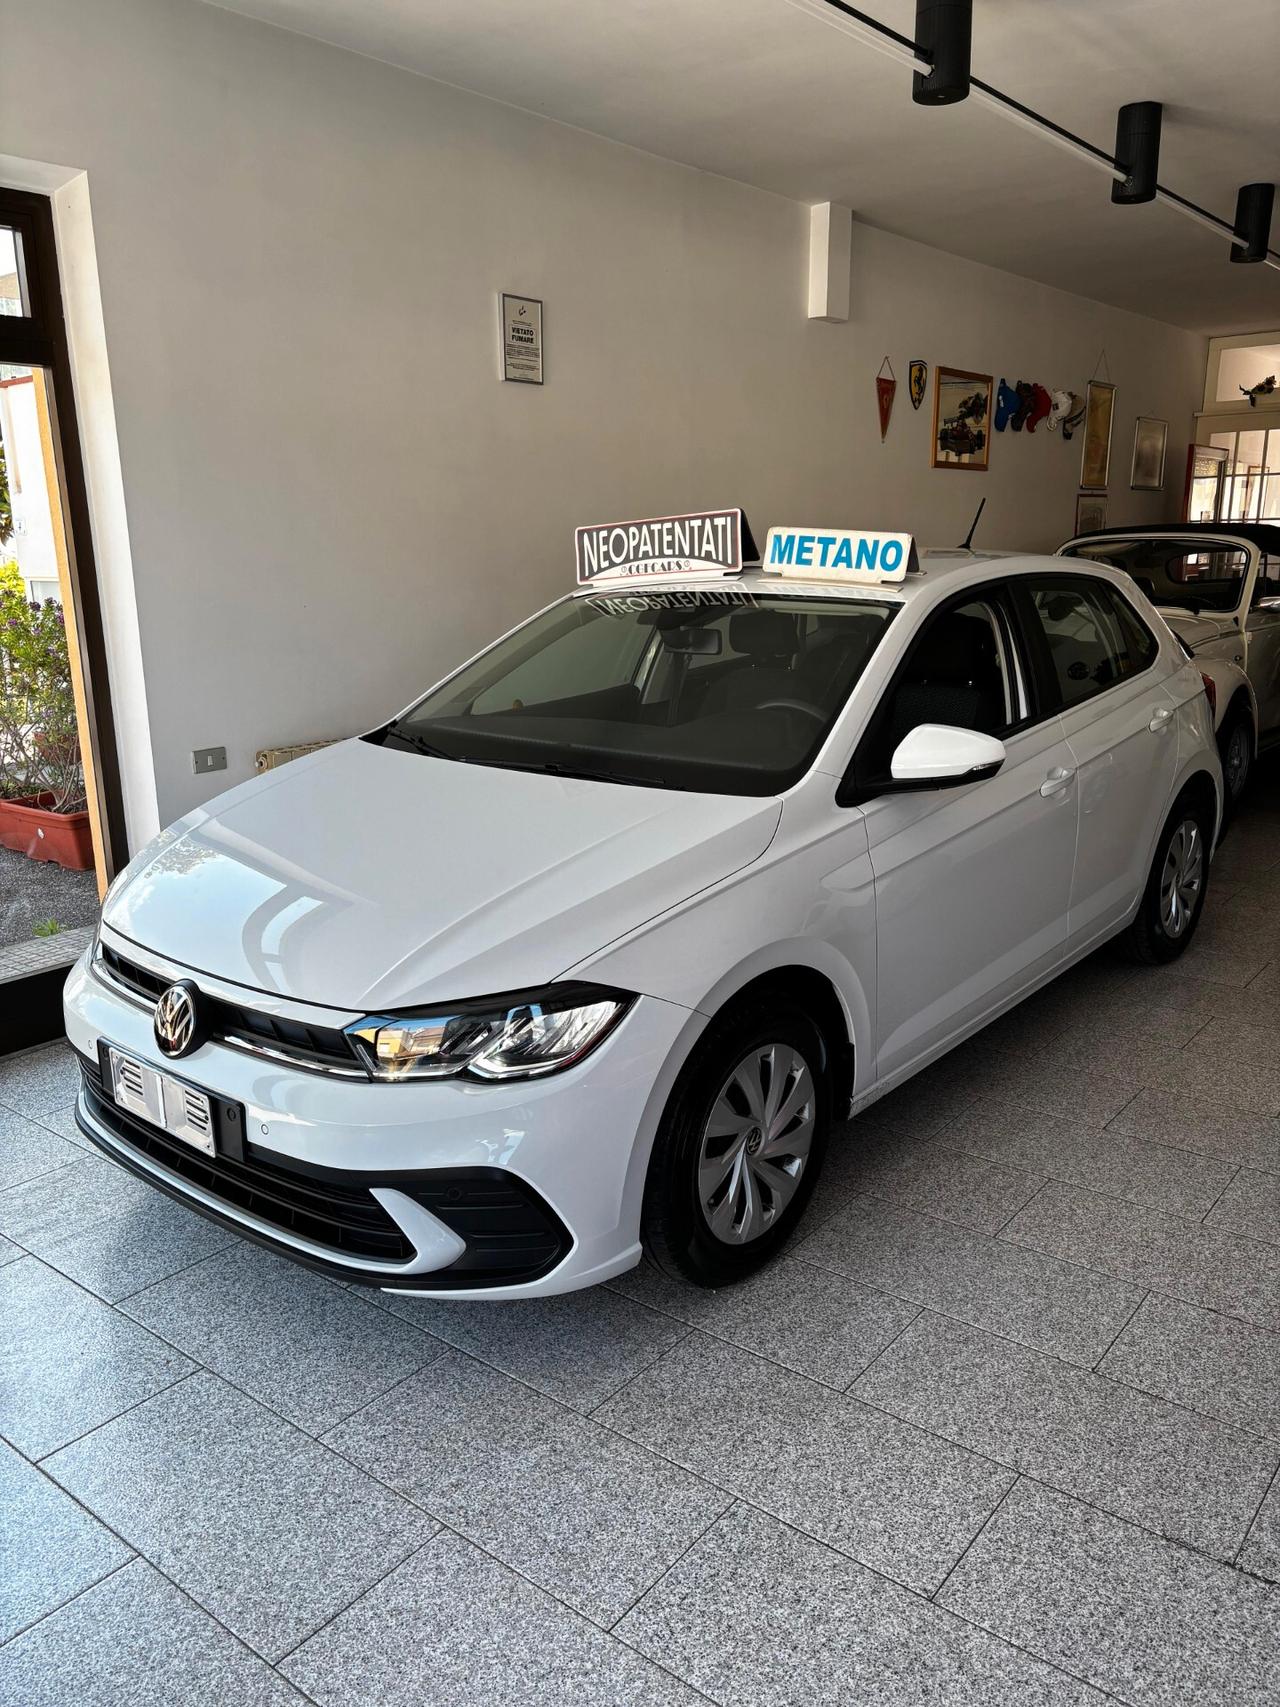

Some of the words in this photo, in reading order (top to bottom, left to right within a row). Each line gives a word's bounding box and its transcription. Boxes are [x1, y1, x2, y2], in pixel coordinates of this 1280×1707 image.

[511, 327, 534, 336] VIETATO
[511, 335, 534, 344] FUMARE
[584, 516, 732, 577] NEOPATENTATI
[769, 534, 903, 572] METANO
